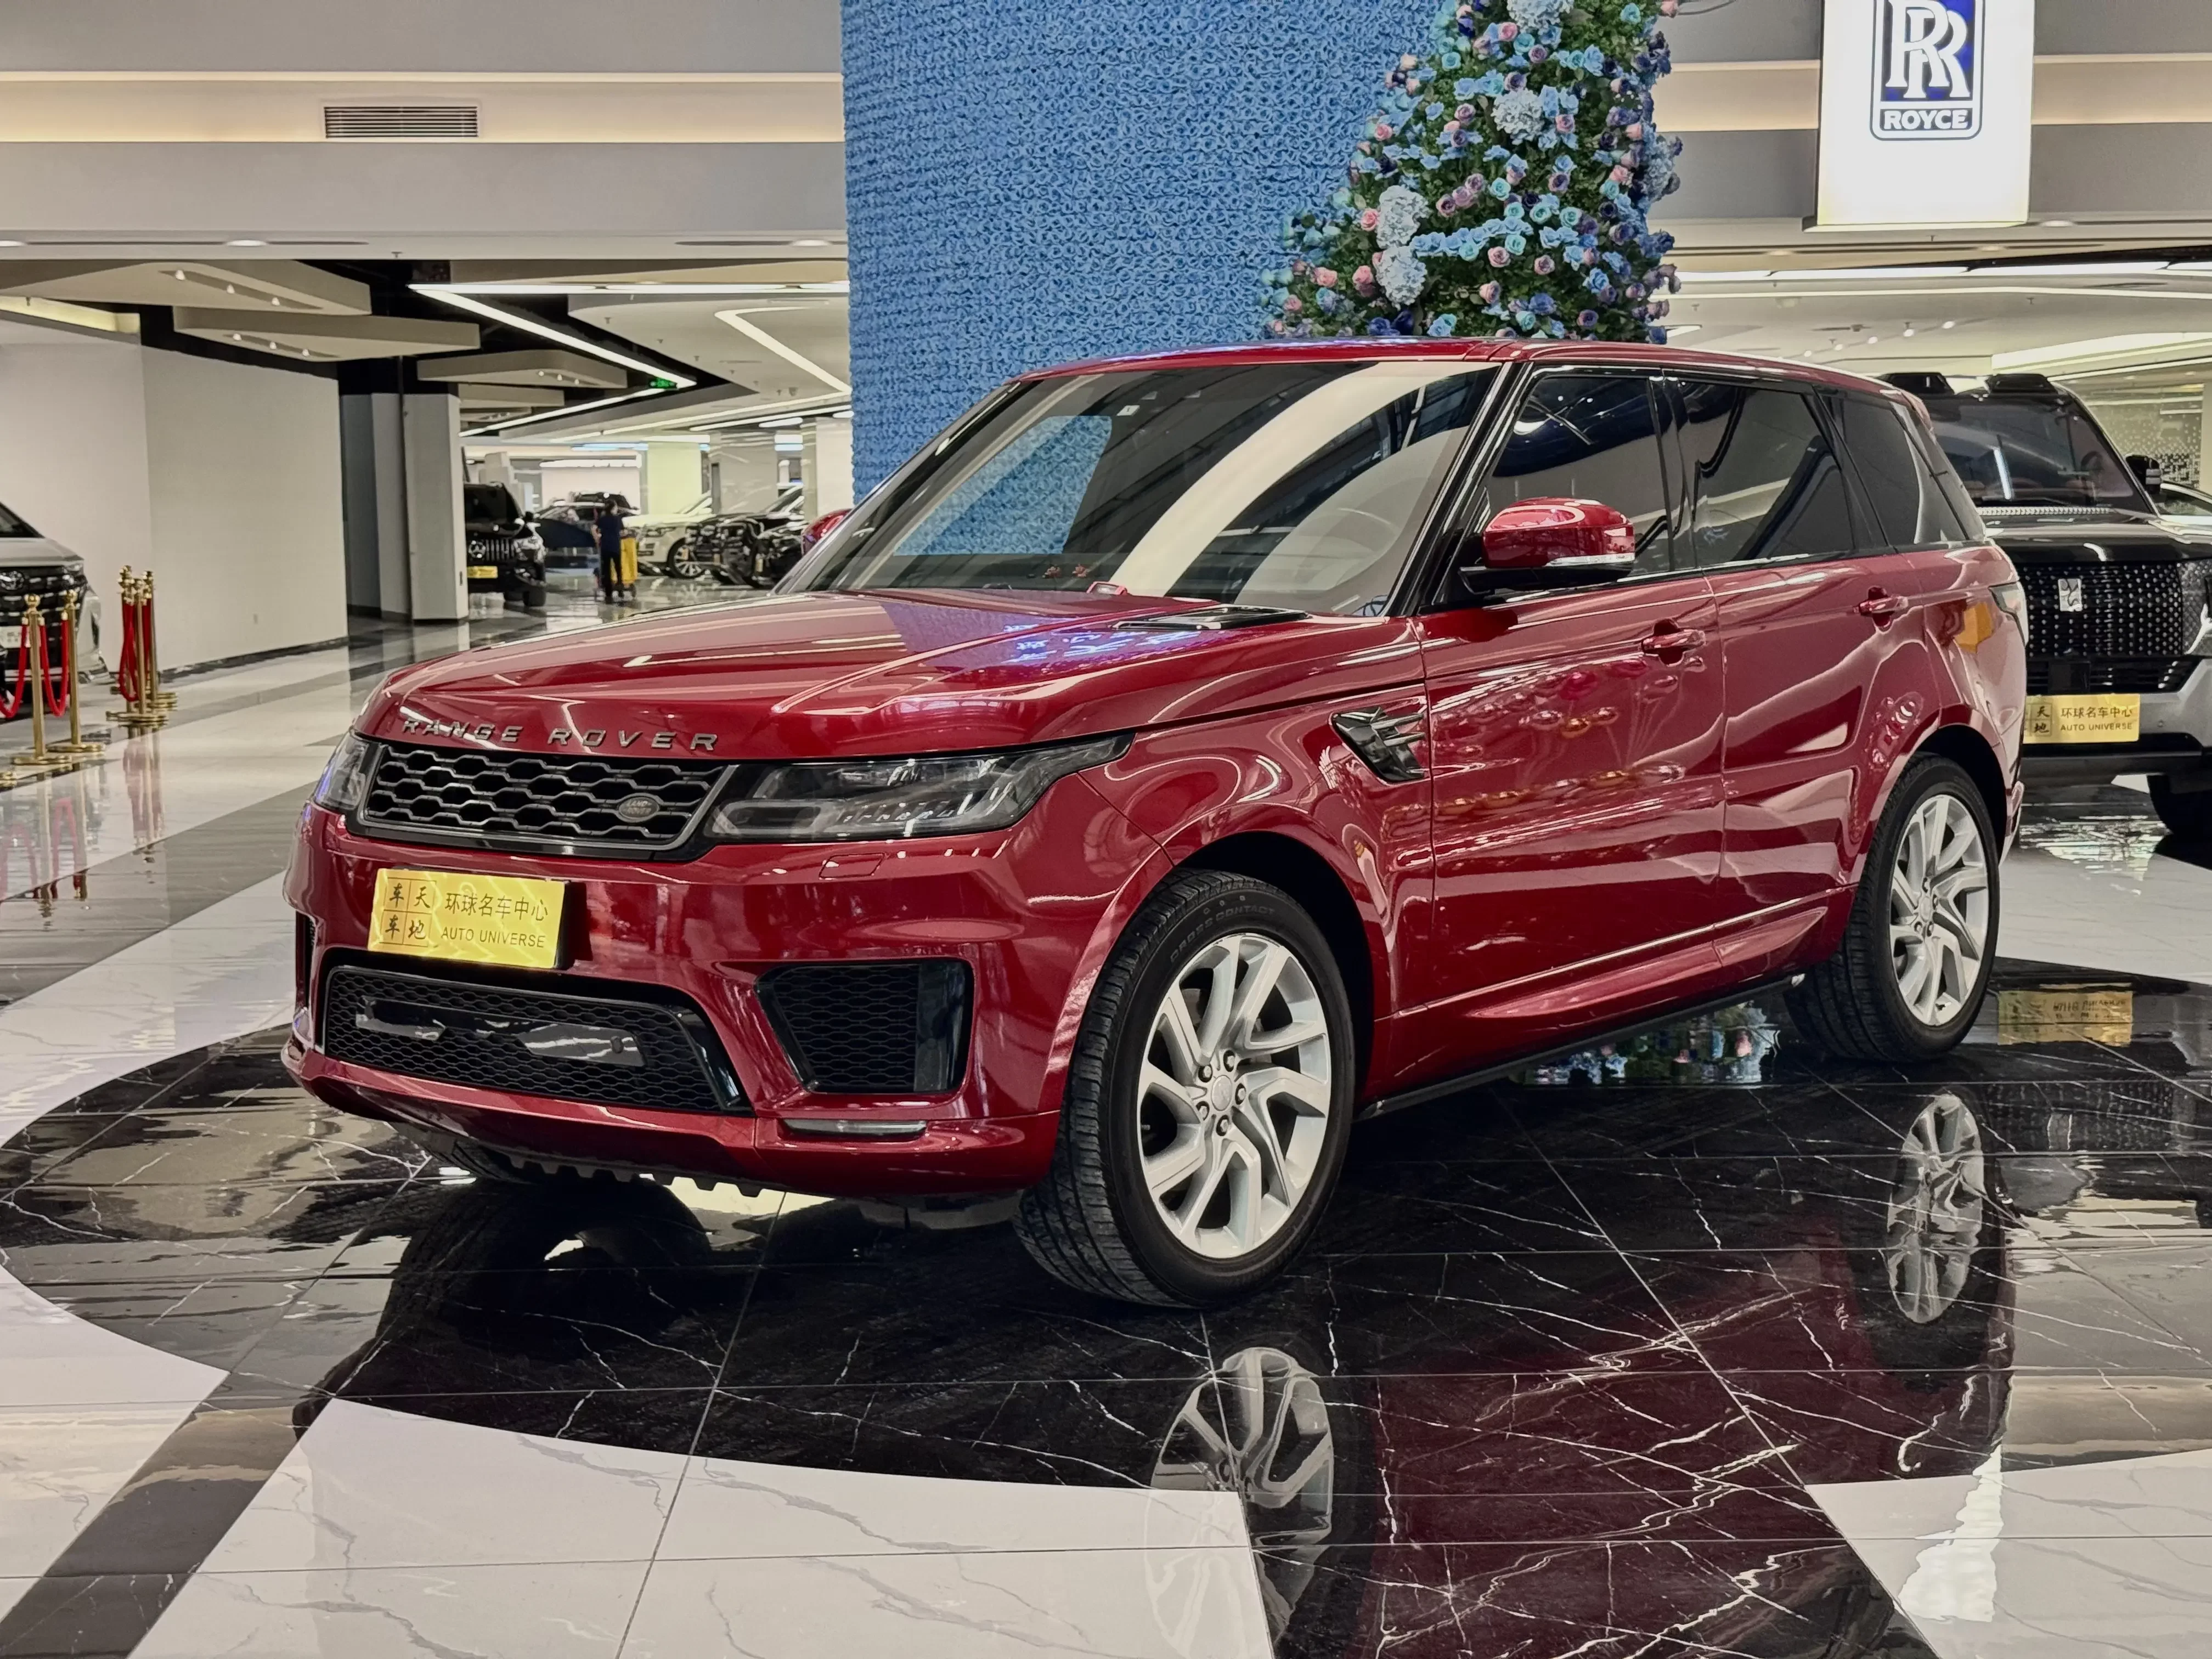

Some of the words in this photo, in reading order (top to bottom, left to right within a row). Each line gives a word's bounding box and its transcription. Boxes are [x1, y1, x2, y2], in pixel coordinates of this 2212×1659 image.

[1883, 110, 1968, 130] ROYCE
[2060, 707, 2133, 719] 环球名车中心
[403, 719, 523, 743] RANGE
[549, 728, 718, 752] ROVER
[2060, 723, 2085, 731] AUTO
[2088, 722, 2133, 731] UNIVERSE
[444, 891, 549, 922] 环球名车中心
[441, 927, 475, 941] AUTO
[479, 930, 546, 949] UNIVERSE
